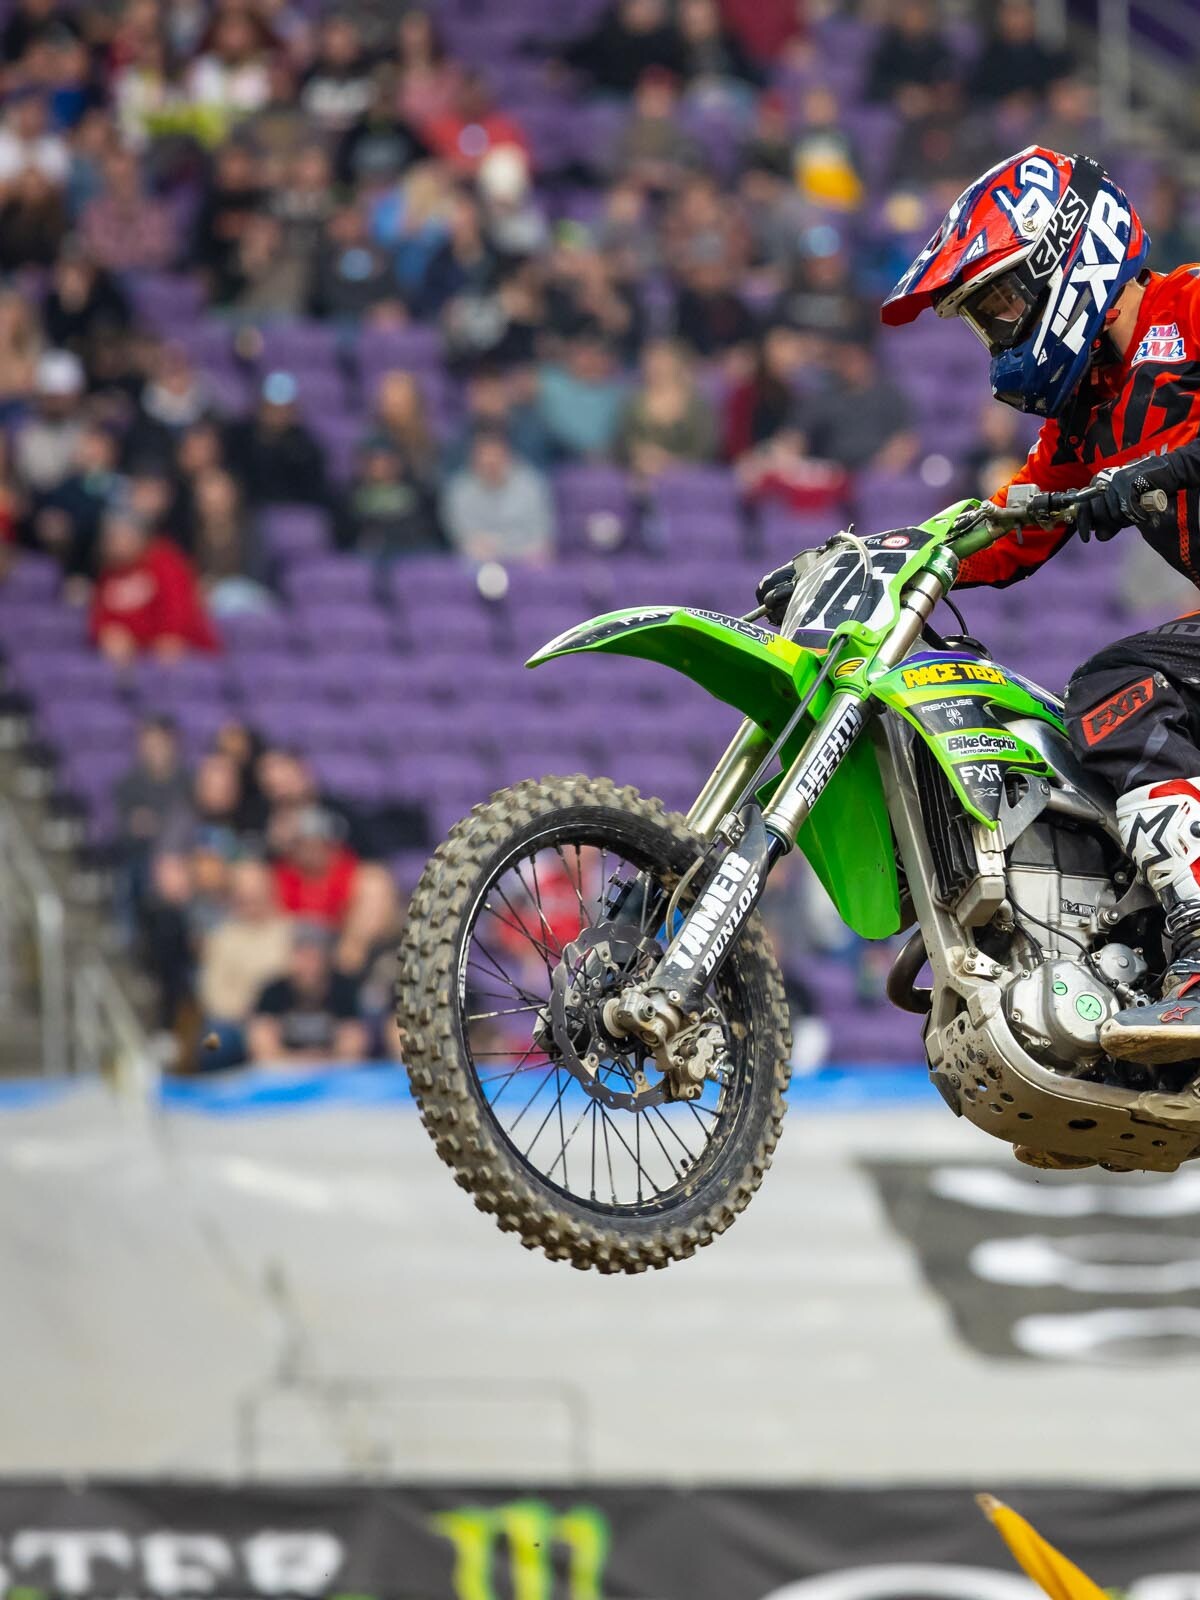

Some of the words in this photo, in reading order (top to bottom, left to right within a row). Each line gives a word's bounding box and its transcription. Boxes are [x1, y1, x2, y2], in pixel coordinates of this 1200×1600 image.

[1051, 190, 1131, 355] FXR
[1148, 324, 1179, 339] AMA
[1134, 339, 1185, 363] AMA
[902, 663, 962, 689] RACE
[963, 663, 1008, 687] TECH
[920, 698, 974, 714] REKLUSE
[1092, 686, 1148, 735] FXR
[959, 763, 1002, 785] FXR
[665, 851, 751, 970] TAMER
[701, 872, 760, 976] DUNLOP
